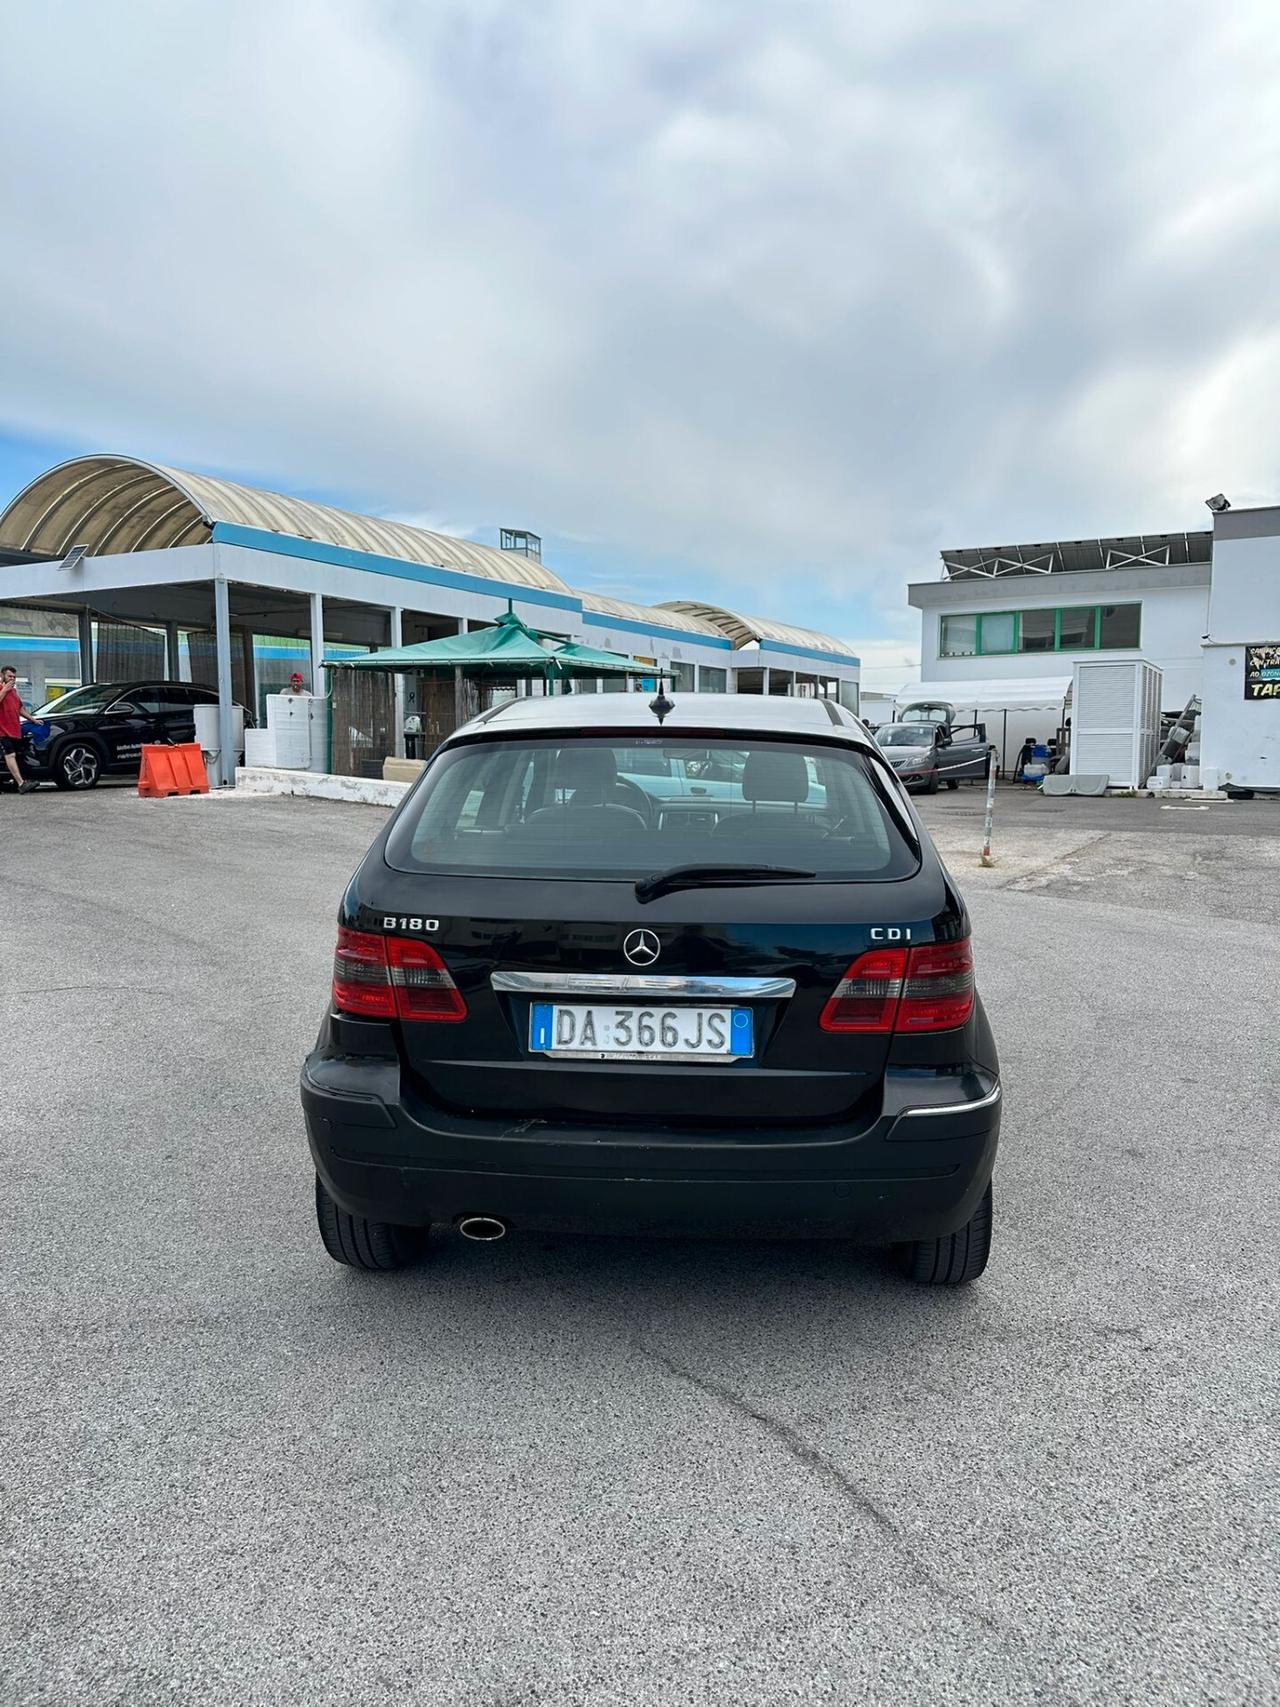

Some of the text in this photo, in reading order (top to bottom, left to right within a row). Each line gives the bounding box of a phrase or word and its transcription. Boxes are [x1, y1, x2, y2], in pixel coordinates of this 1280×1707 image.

[383, 916, 440, 931] B180
[870, 927, 911, 940] CDI
[556, 1008, 597, 1046] DA
